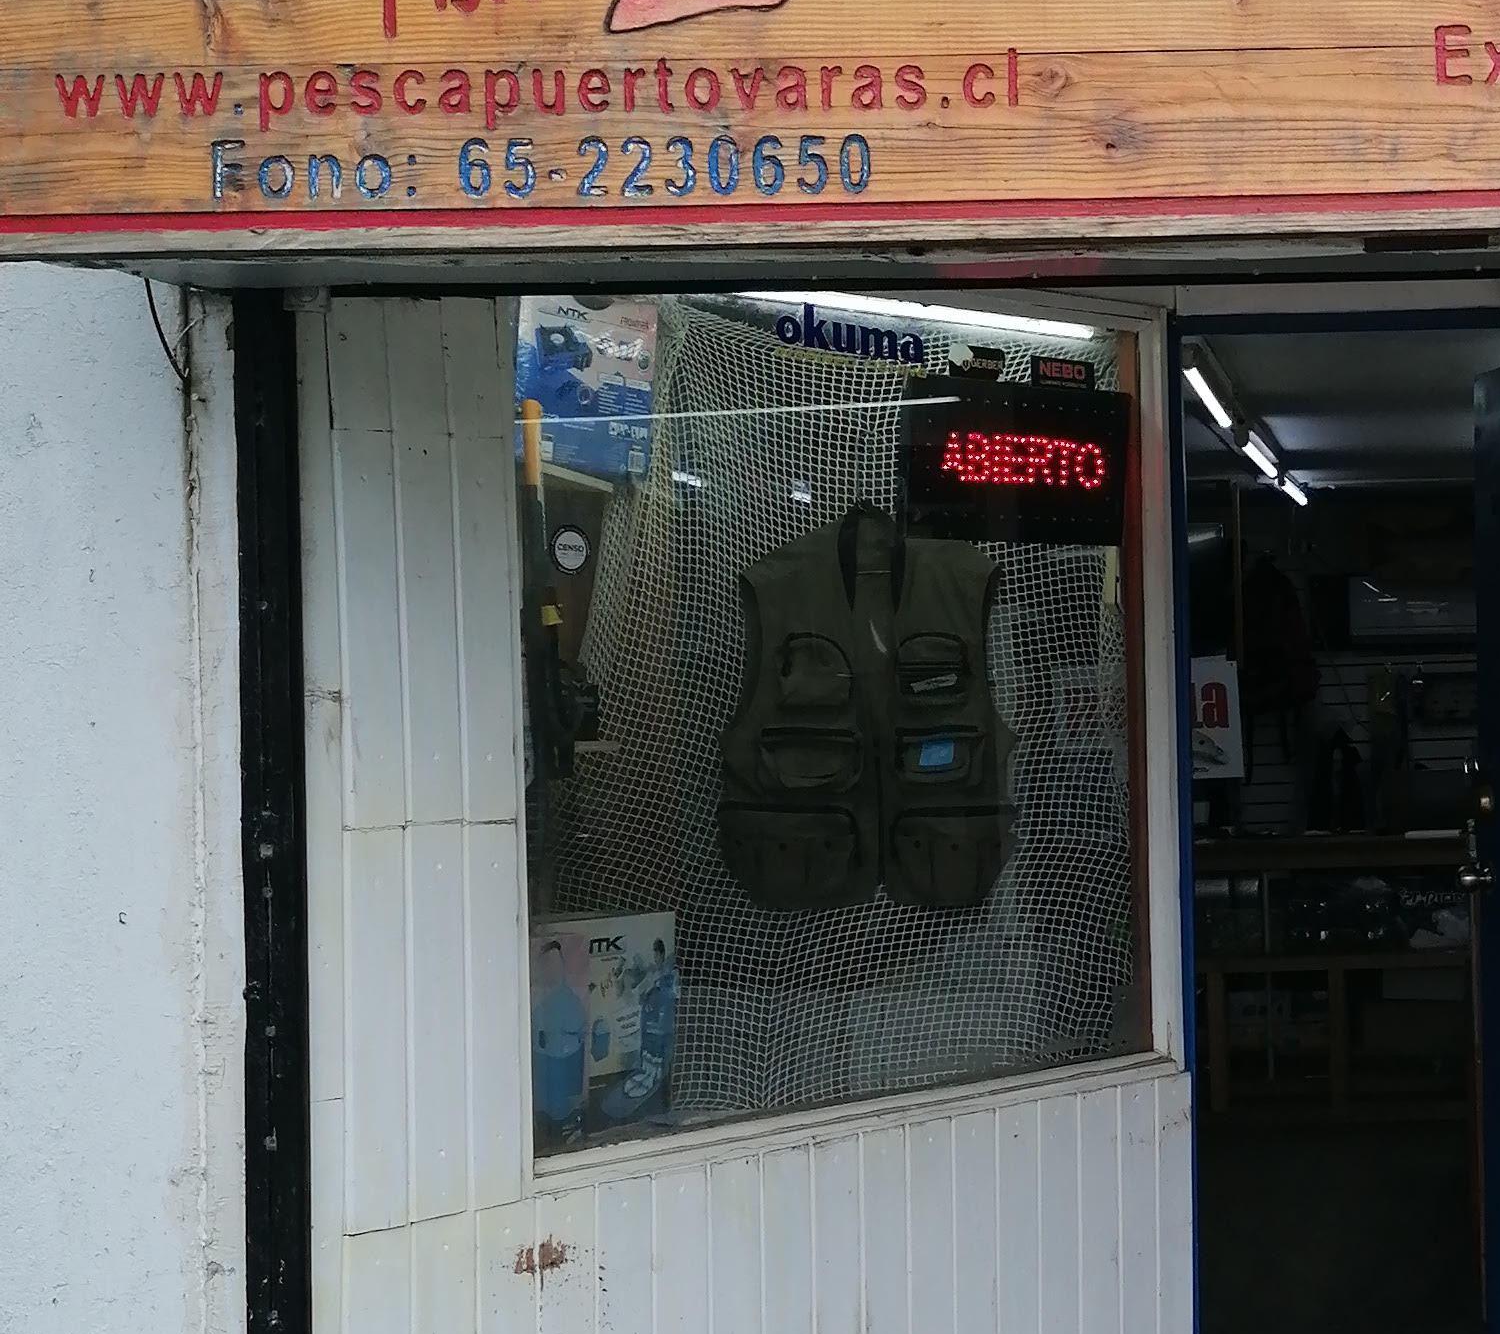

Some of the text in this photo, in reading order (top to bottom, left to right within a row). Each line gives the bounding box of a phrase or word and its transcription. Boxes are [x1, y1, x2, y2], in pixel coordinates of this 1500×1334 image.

[55, 47, 1021, 133] www.pescapuertovaras.cl
[210, 133, 874, 201] Fono: 65-2230650
[775, 301, 925, 364] okuma
[1038, 360, 1087, 382] NEBO
